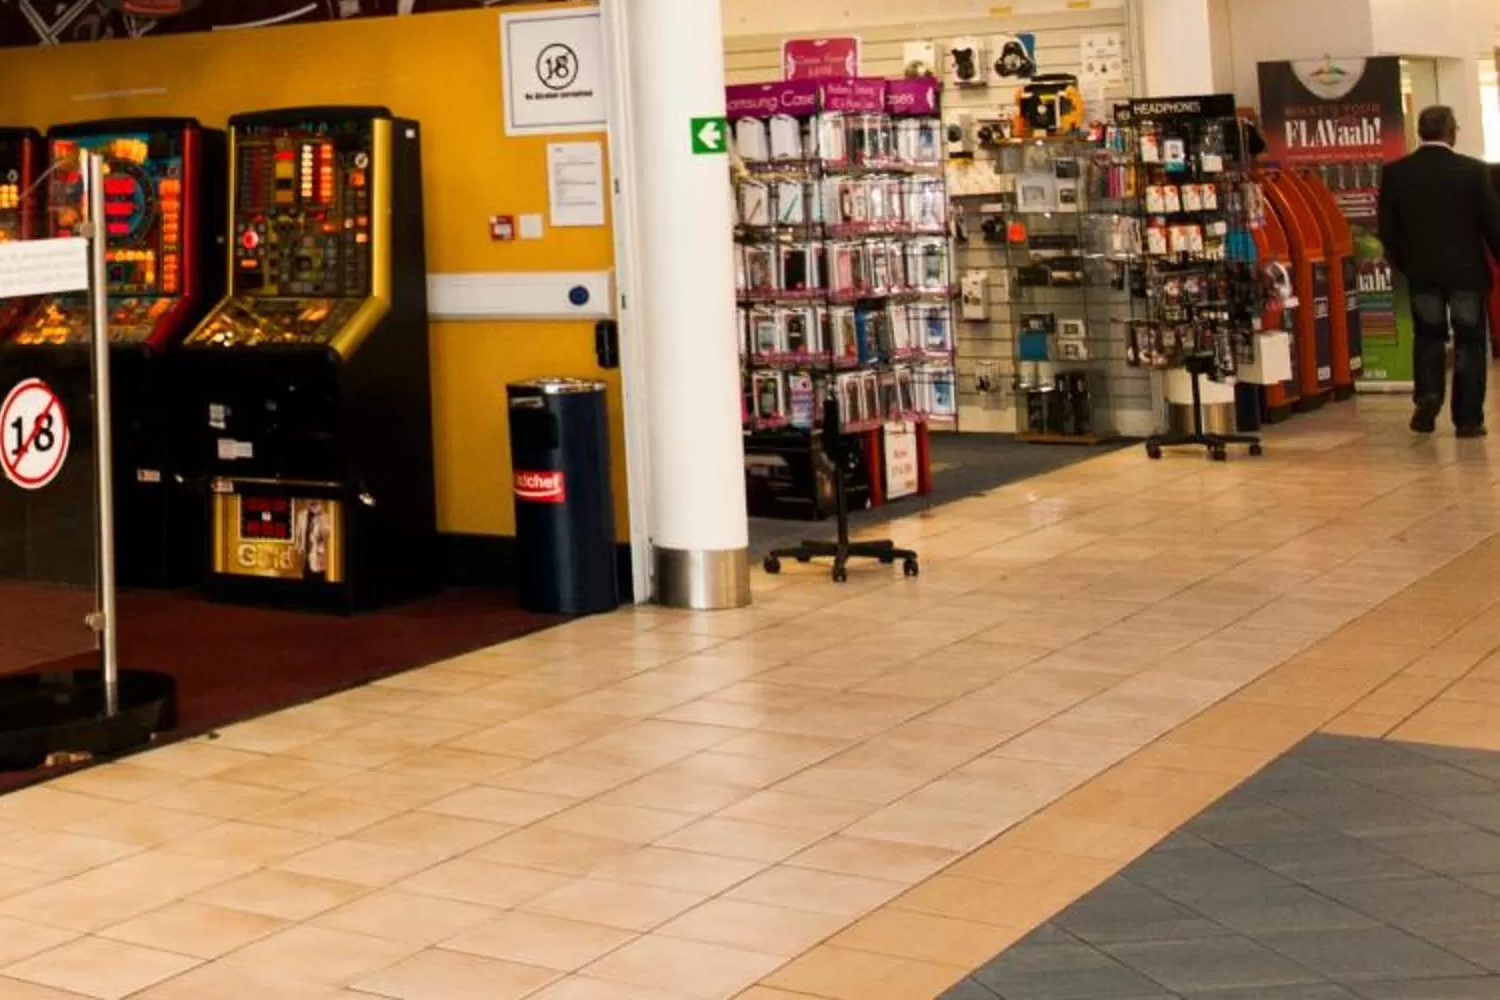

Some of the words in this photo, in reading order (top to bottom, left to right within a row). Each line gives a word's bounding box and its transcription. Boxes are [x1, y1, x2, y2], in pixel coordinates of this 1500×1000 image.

[1133, 101, 1201, 116] HEADPHONES
[1284, 116, 1382, 148] FLAVaah!
[11, 413, 54, 455] 18
